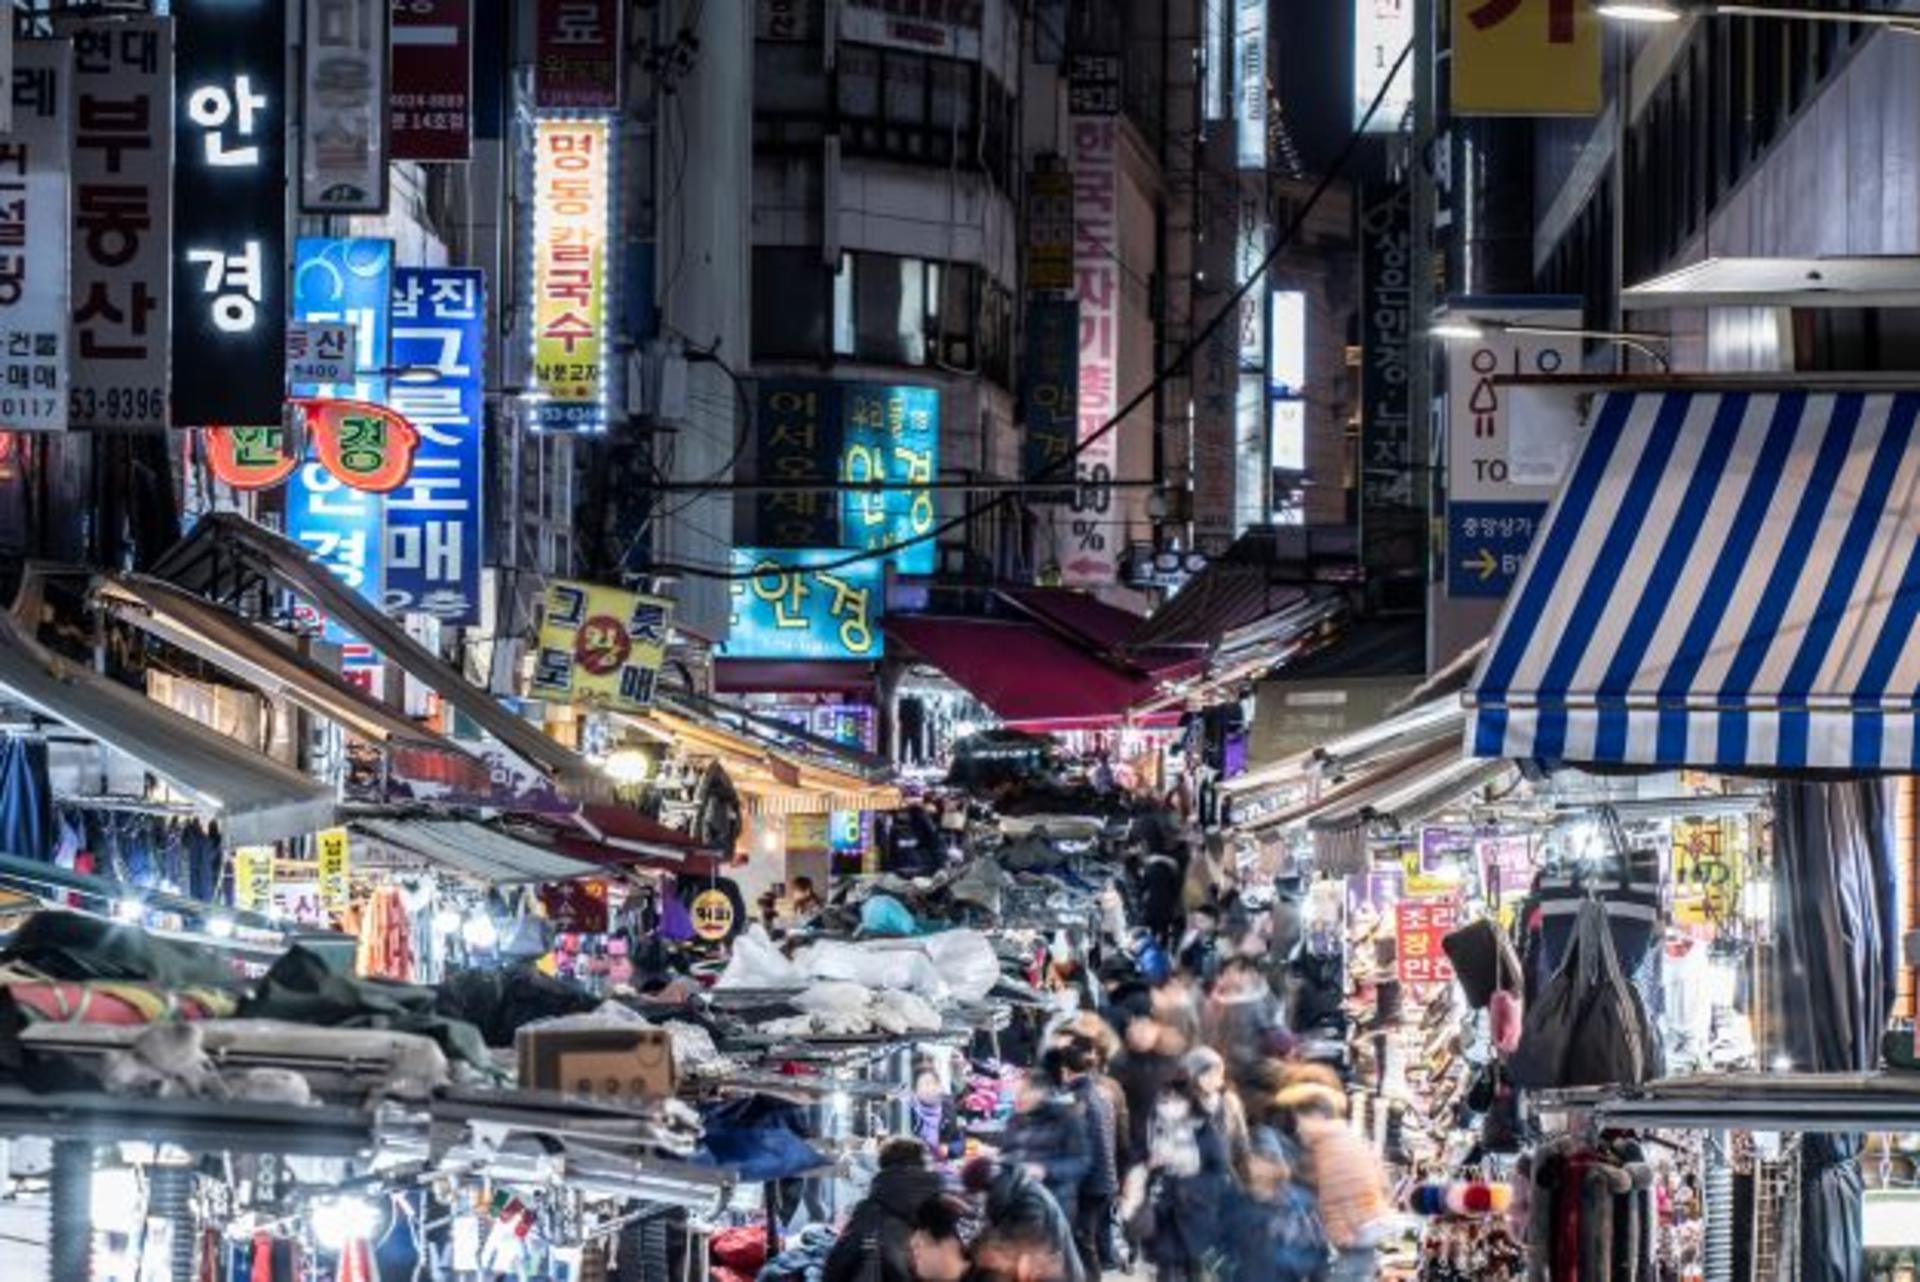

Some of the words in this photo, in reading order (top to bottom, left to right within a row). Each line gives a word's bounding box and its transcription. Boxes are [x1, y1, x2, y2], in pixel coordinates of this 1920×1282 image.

[75, 32, 158, 74] 현대
[74, 95, 156, 360] 부동산
[188, 74, 267, 333] 안경
[752, 560, 872, 653] 안경
